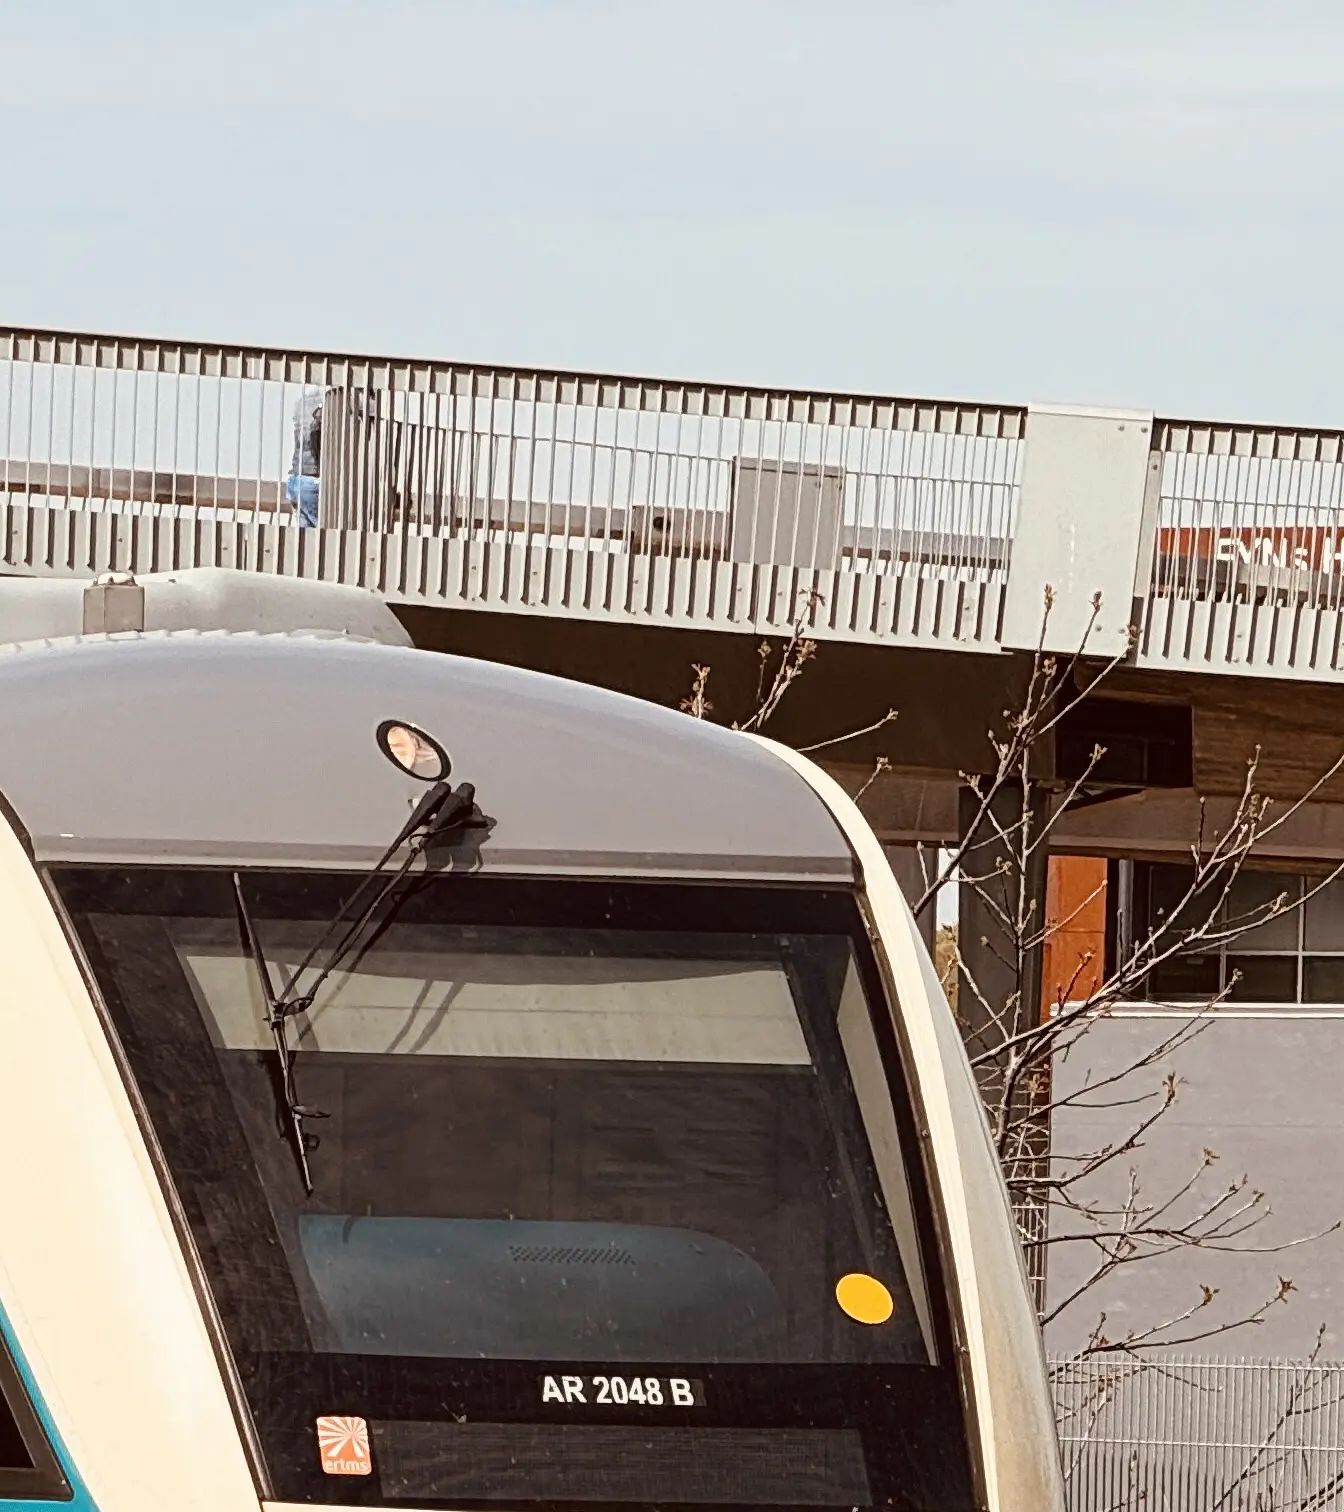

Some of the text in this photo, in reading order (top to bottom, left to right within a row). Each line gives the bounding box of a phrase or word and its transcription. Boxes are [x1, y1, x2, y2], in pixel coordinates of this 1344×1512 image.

[542, 1375, 695, 1406] AR 2048 B
[325, 1458, 369, 1473] ertms
